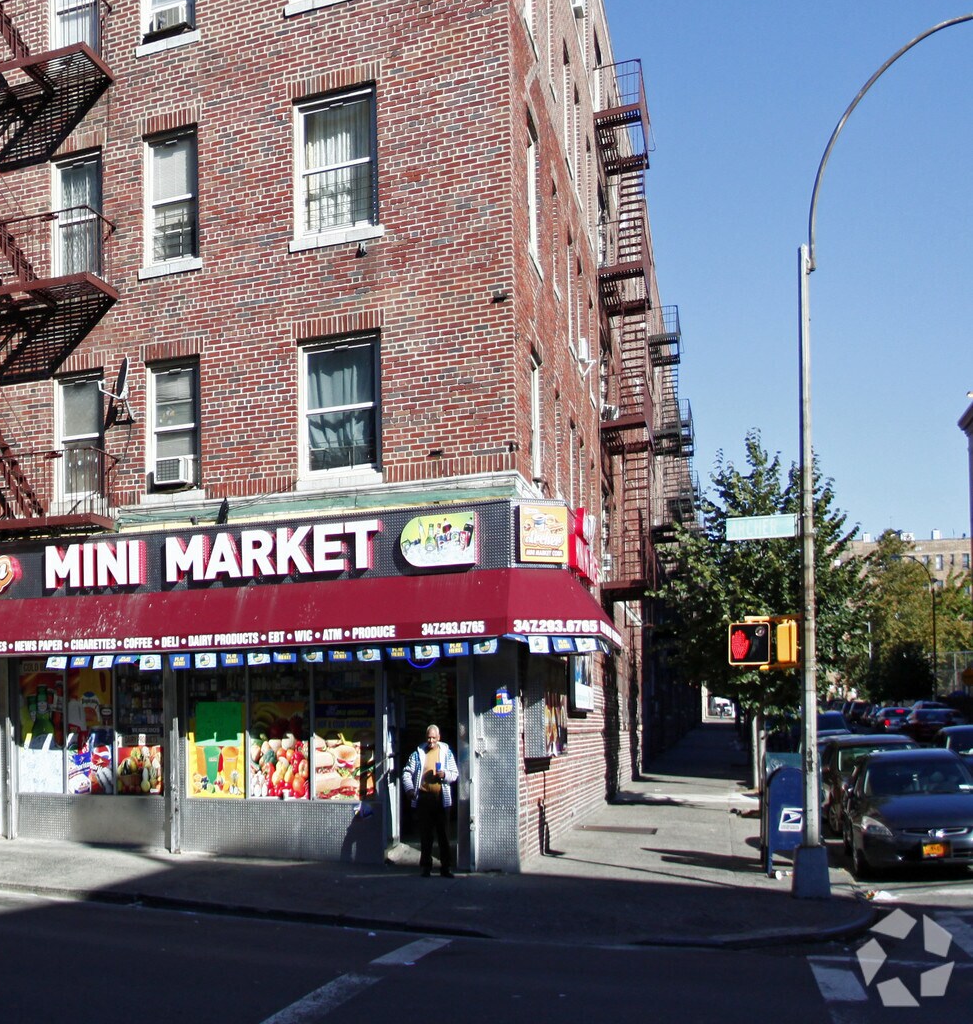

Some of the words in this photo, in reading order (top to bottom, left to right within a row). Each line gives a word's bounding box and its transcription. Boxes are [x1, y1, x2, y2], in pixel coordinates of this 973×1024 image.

[730, 519, 777, 536] ARCHER
[45, 540, 142, 589] MINI
[165, 519, 381, 583] MARKET
[14, 640, 37, 652] NEWS
[38, 639, 62, 651] PAPER
[70, 638, 117, 650] CIGARETTES
[123, 637, 152, 649] COFFEE
[161, 636, 179, 648] DELI
[188, 634, 212, 647] DAIRY
[214, 632, 259, 645] PRODUCTS
[268, 631, 285, 643] EBT
[294, 630, 313, 642] WIC
[322, 628, 342, 641] ATM
[352, 625, 395, 639] PRODUCE
[421, 621, 485, 636] 347.293.6765
